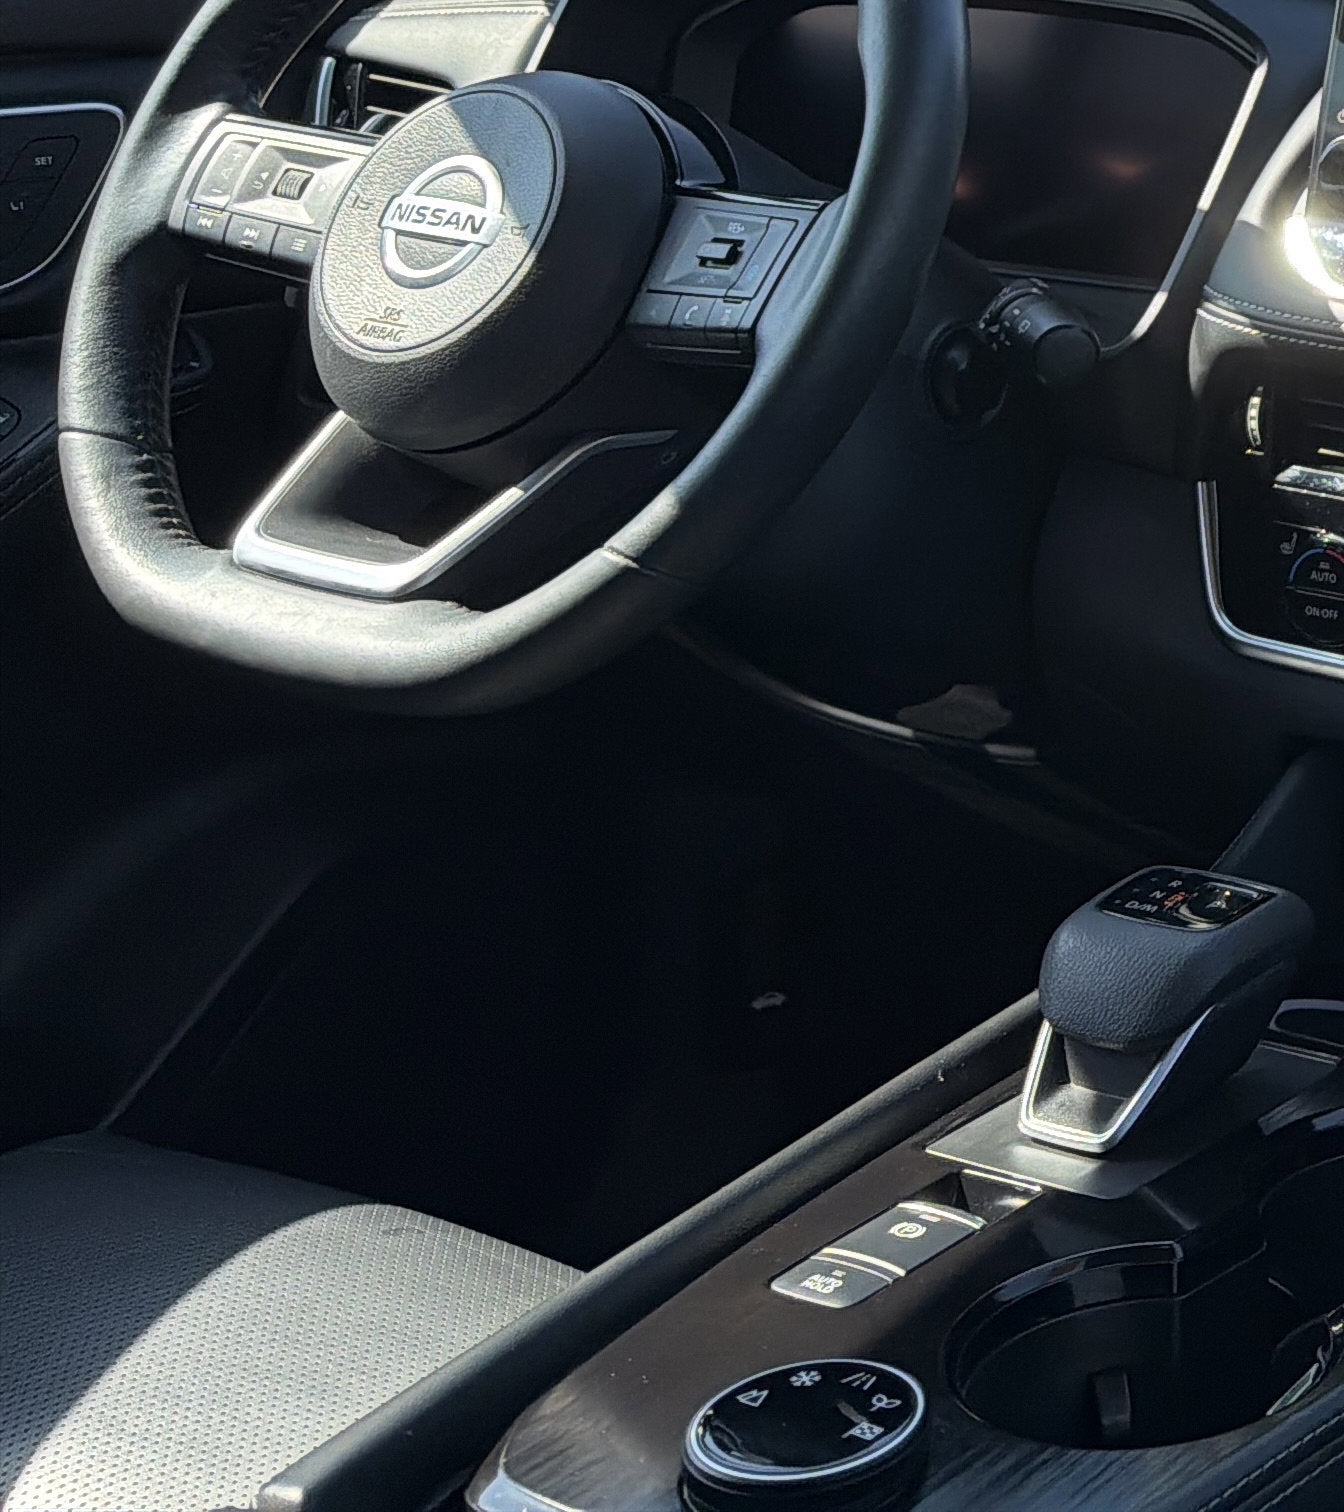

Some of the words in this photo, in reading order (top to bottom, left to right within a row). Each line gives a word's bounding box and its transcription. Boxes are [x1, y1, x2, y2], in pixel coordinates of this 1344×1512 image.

[34, 155, 53, 166] SET
[390, 202, 488, 235] NISSAN
[378, 305, 402, 322] SRS
[1309, 569, 1338, 584] AUTO
[799, 1279, 836, 1294] HOLD
[809, 1273, 844, 1288] AUTO
